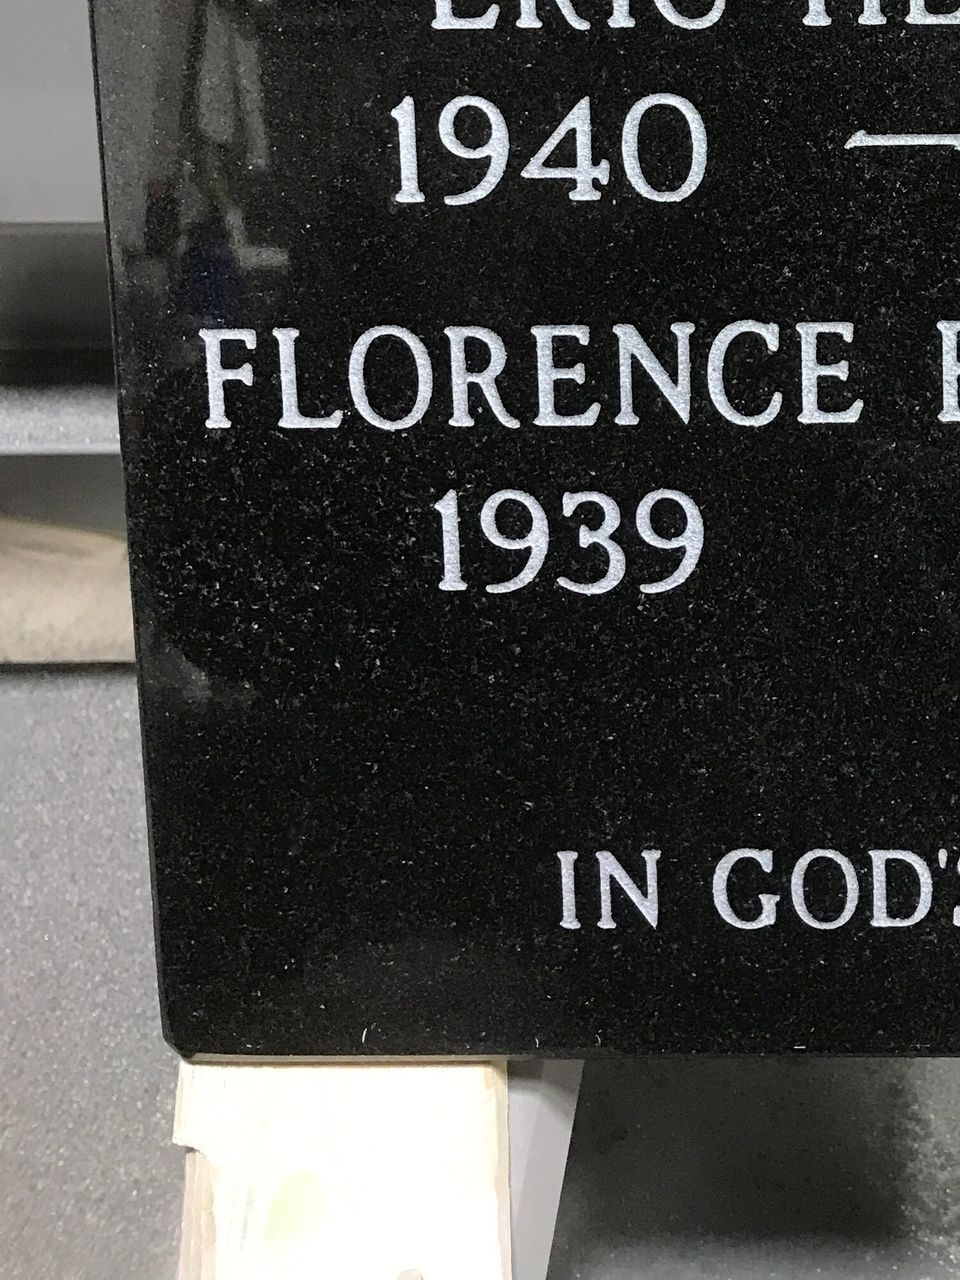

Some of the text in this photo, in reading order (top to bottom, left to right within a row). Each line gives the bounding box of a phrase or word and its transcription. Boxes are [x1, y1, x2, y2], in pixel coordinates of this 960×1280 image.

[390, 92, 708, 206] 1940
[198, 319, 864, 432] FLORENCE
[433, 487, 704, 597] 1939
[556, 849, 662, 930] IN
